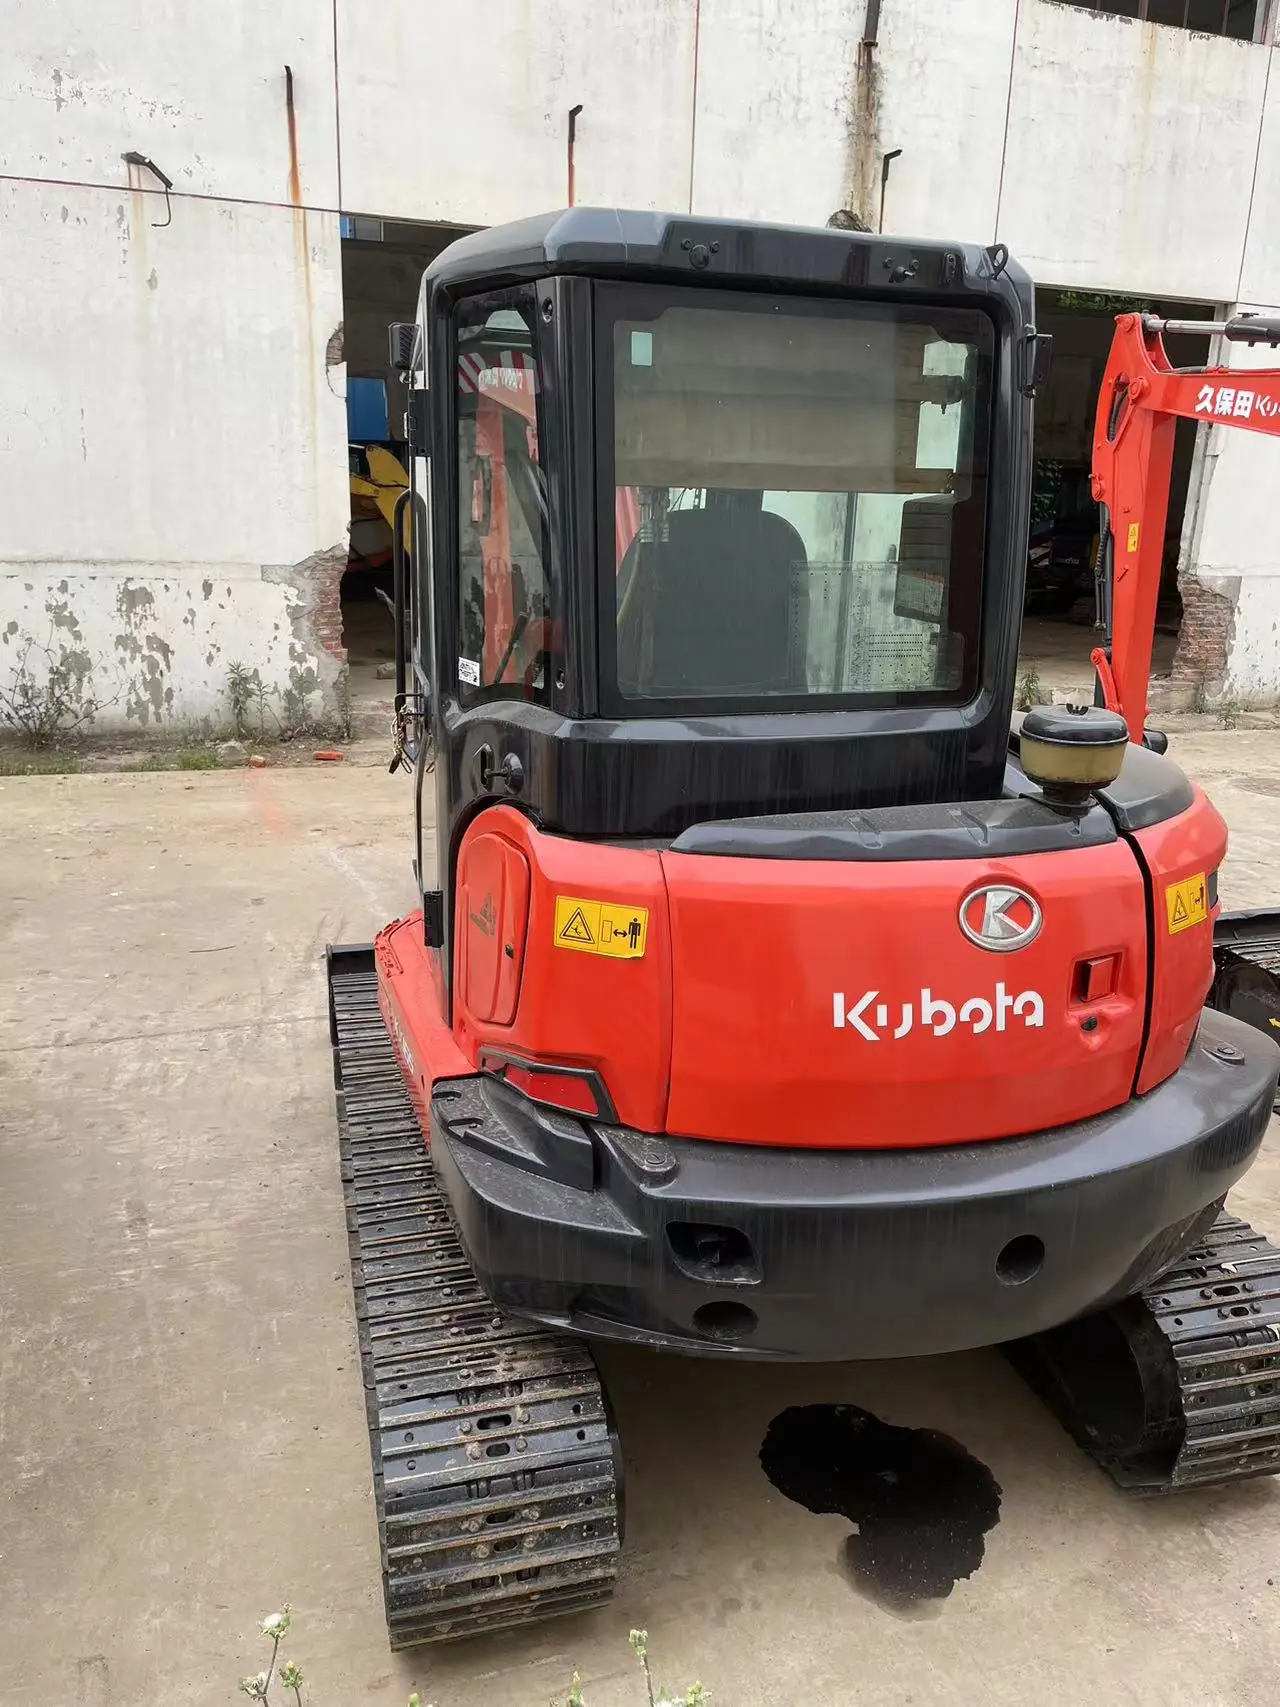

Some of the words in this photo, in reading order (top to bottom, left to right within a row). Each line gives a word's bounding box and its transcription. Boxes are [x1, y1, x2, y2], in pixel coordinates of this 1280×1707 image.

[1195, 384, 1255, 418] 久保田
[1255, 395, 1280, 416] Ku
[833, 982, 1044, 1041] Kubota
